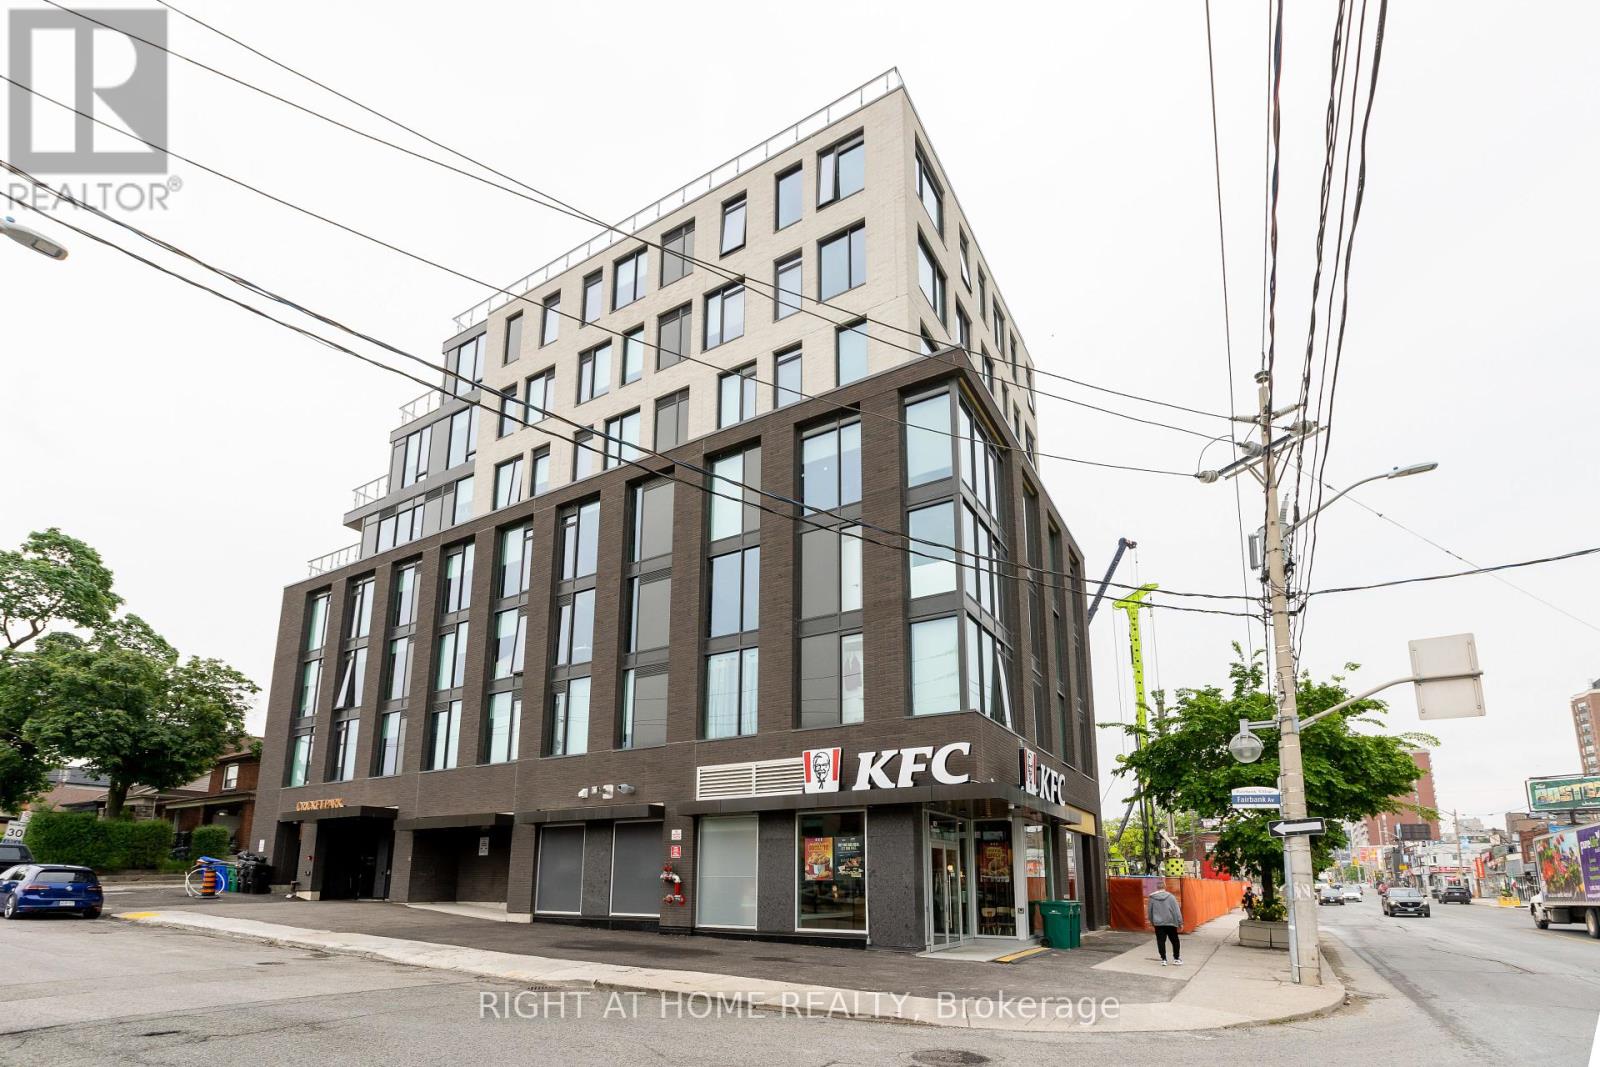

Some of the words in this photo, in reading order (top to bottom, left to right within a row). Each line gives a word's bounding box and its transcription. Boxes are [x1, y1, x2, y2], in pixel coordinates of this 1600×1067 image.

[852, 742, 971, 791] KFC
[1040, 763, 1066, 807] KFC
[7, 828, 23, 838] 30
